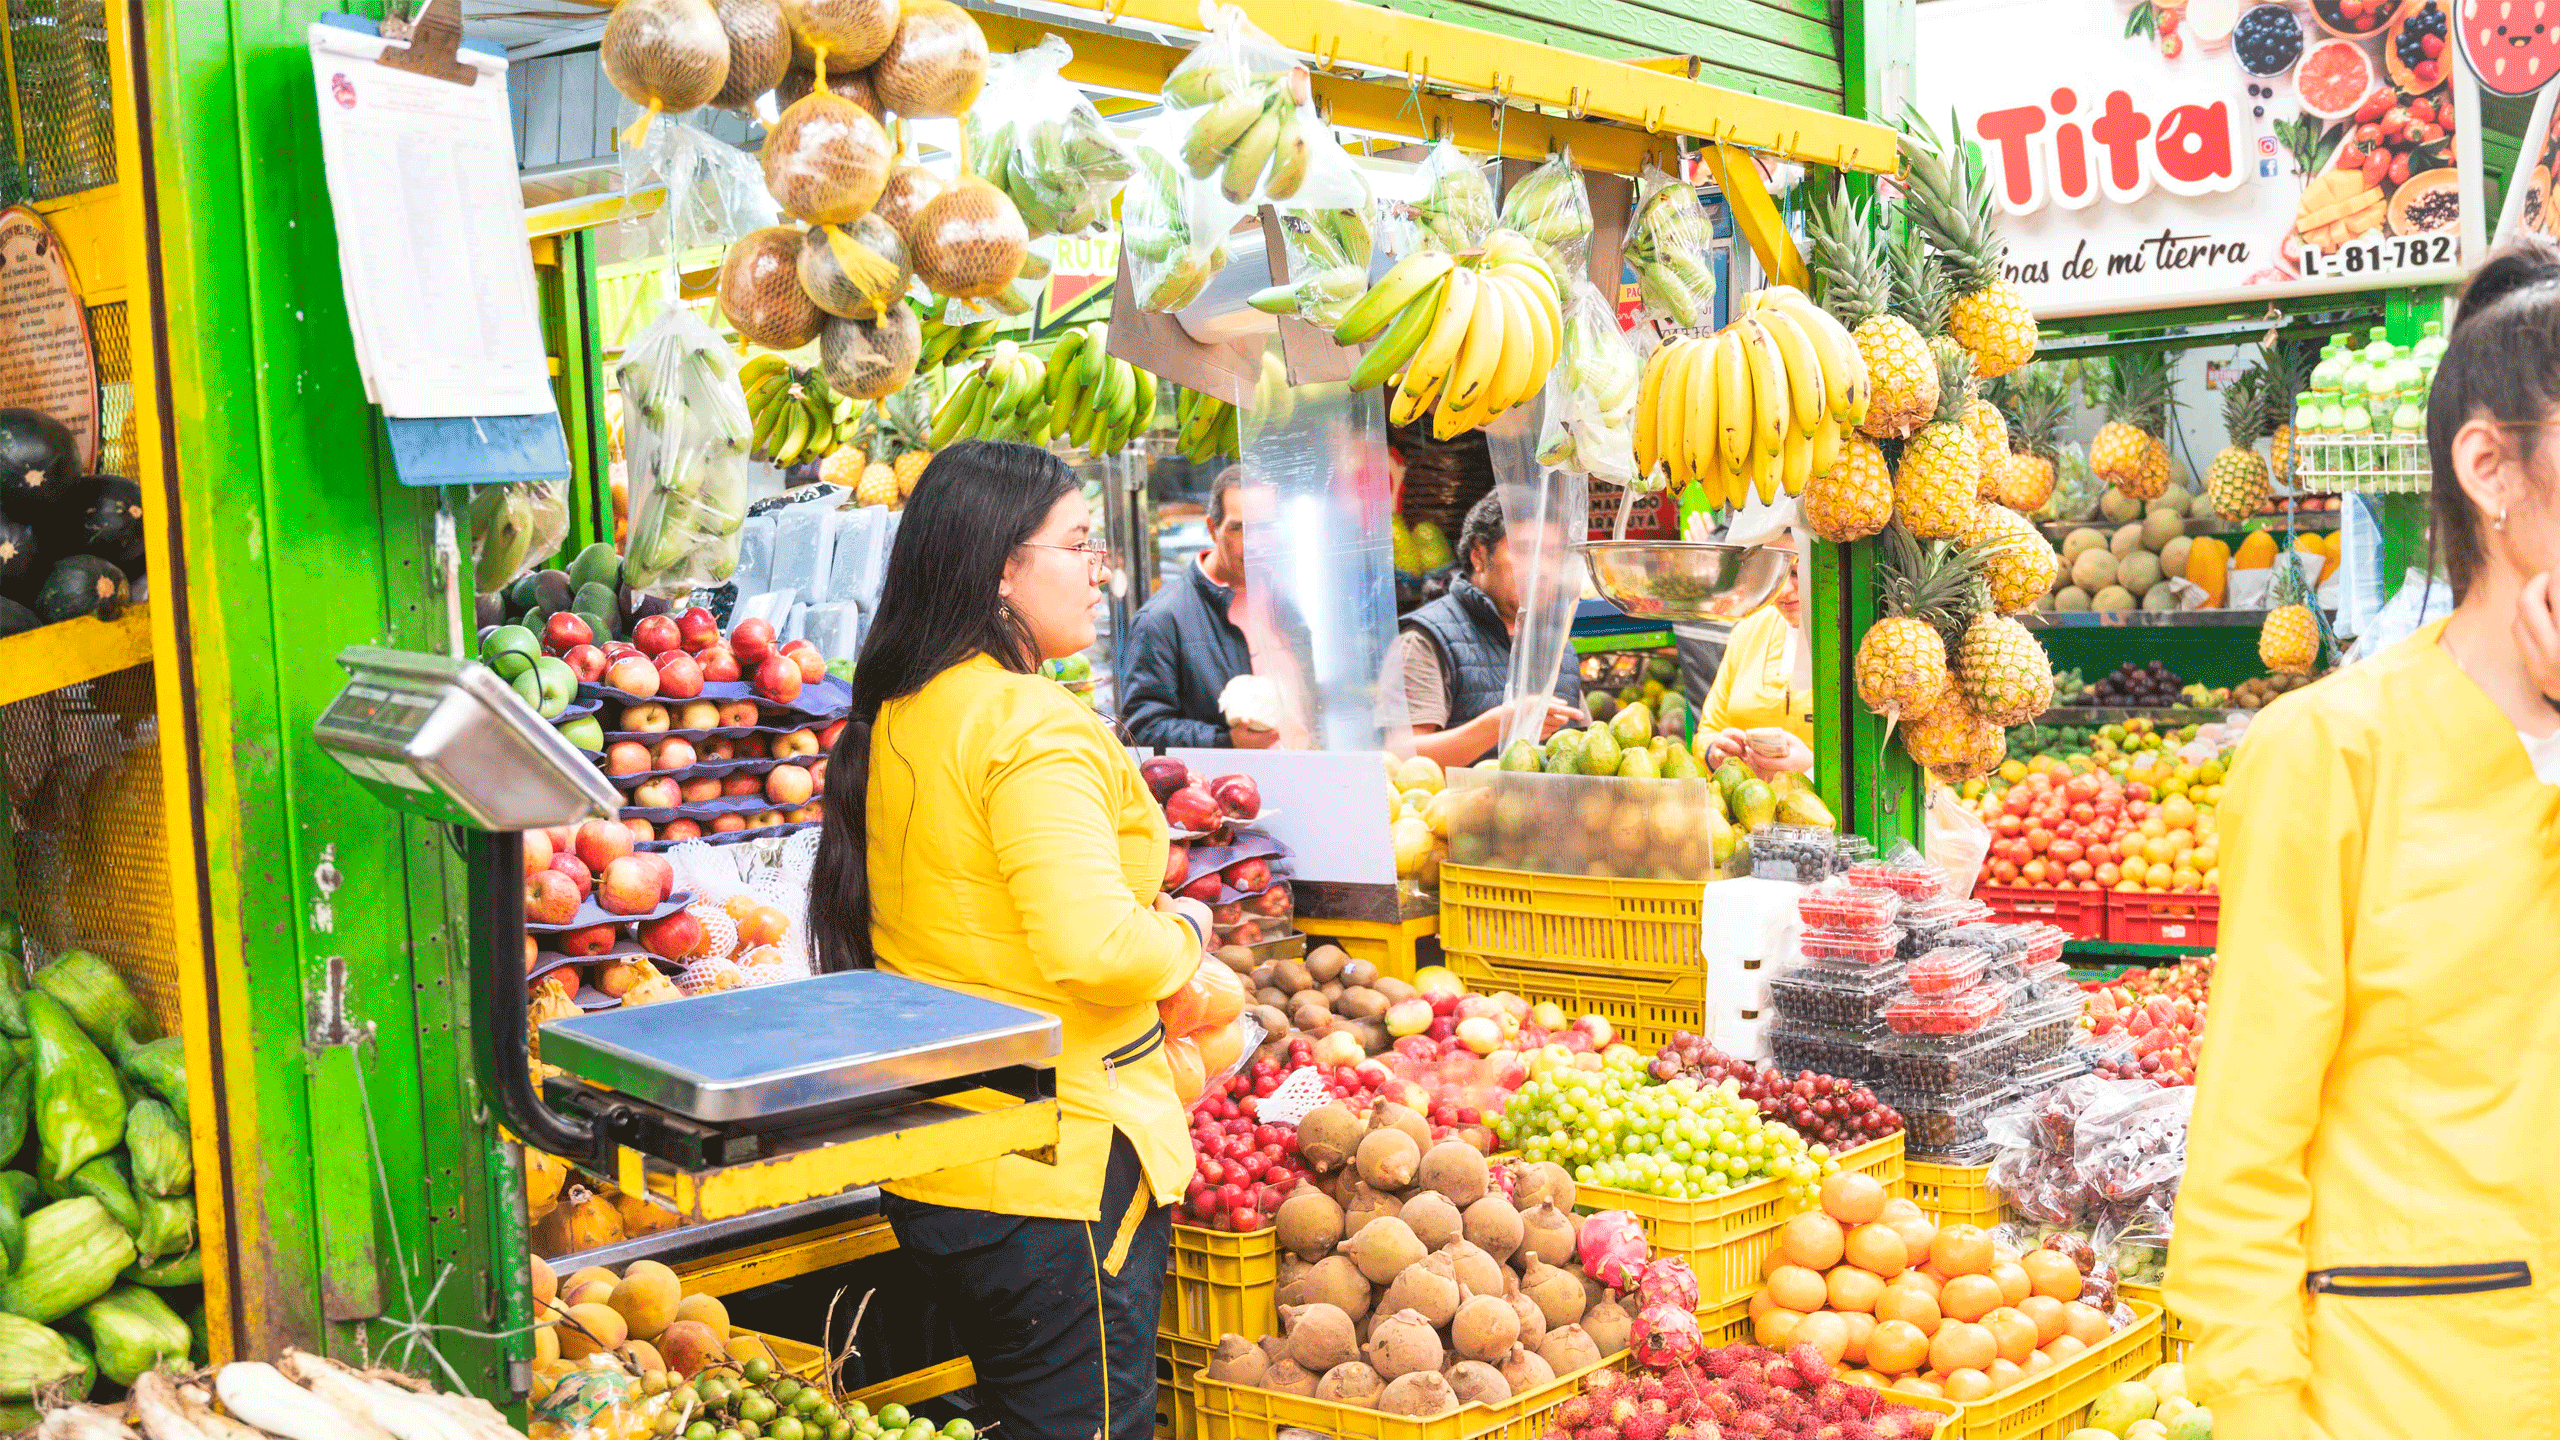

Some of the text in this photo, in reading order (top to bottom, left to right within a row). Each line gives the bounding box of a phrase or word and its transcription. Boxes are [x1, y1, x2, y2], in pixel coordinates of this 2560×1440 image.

[1976, 87, 2232, 205] Tita
[2062, 239, 2098, 280] de
[2107, 244, 2146, 276] mi
[2144, 228, 2250, 270] tierra
[2305, 251, 2319, 276] L
[2345, 237, 2450, 272] 81-782
